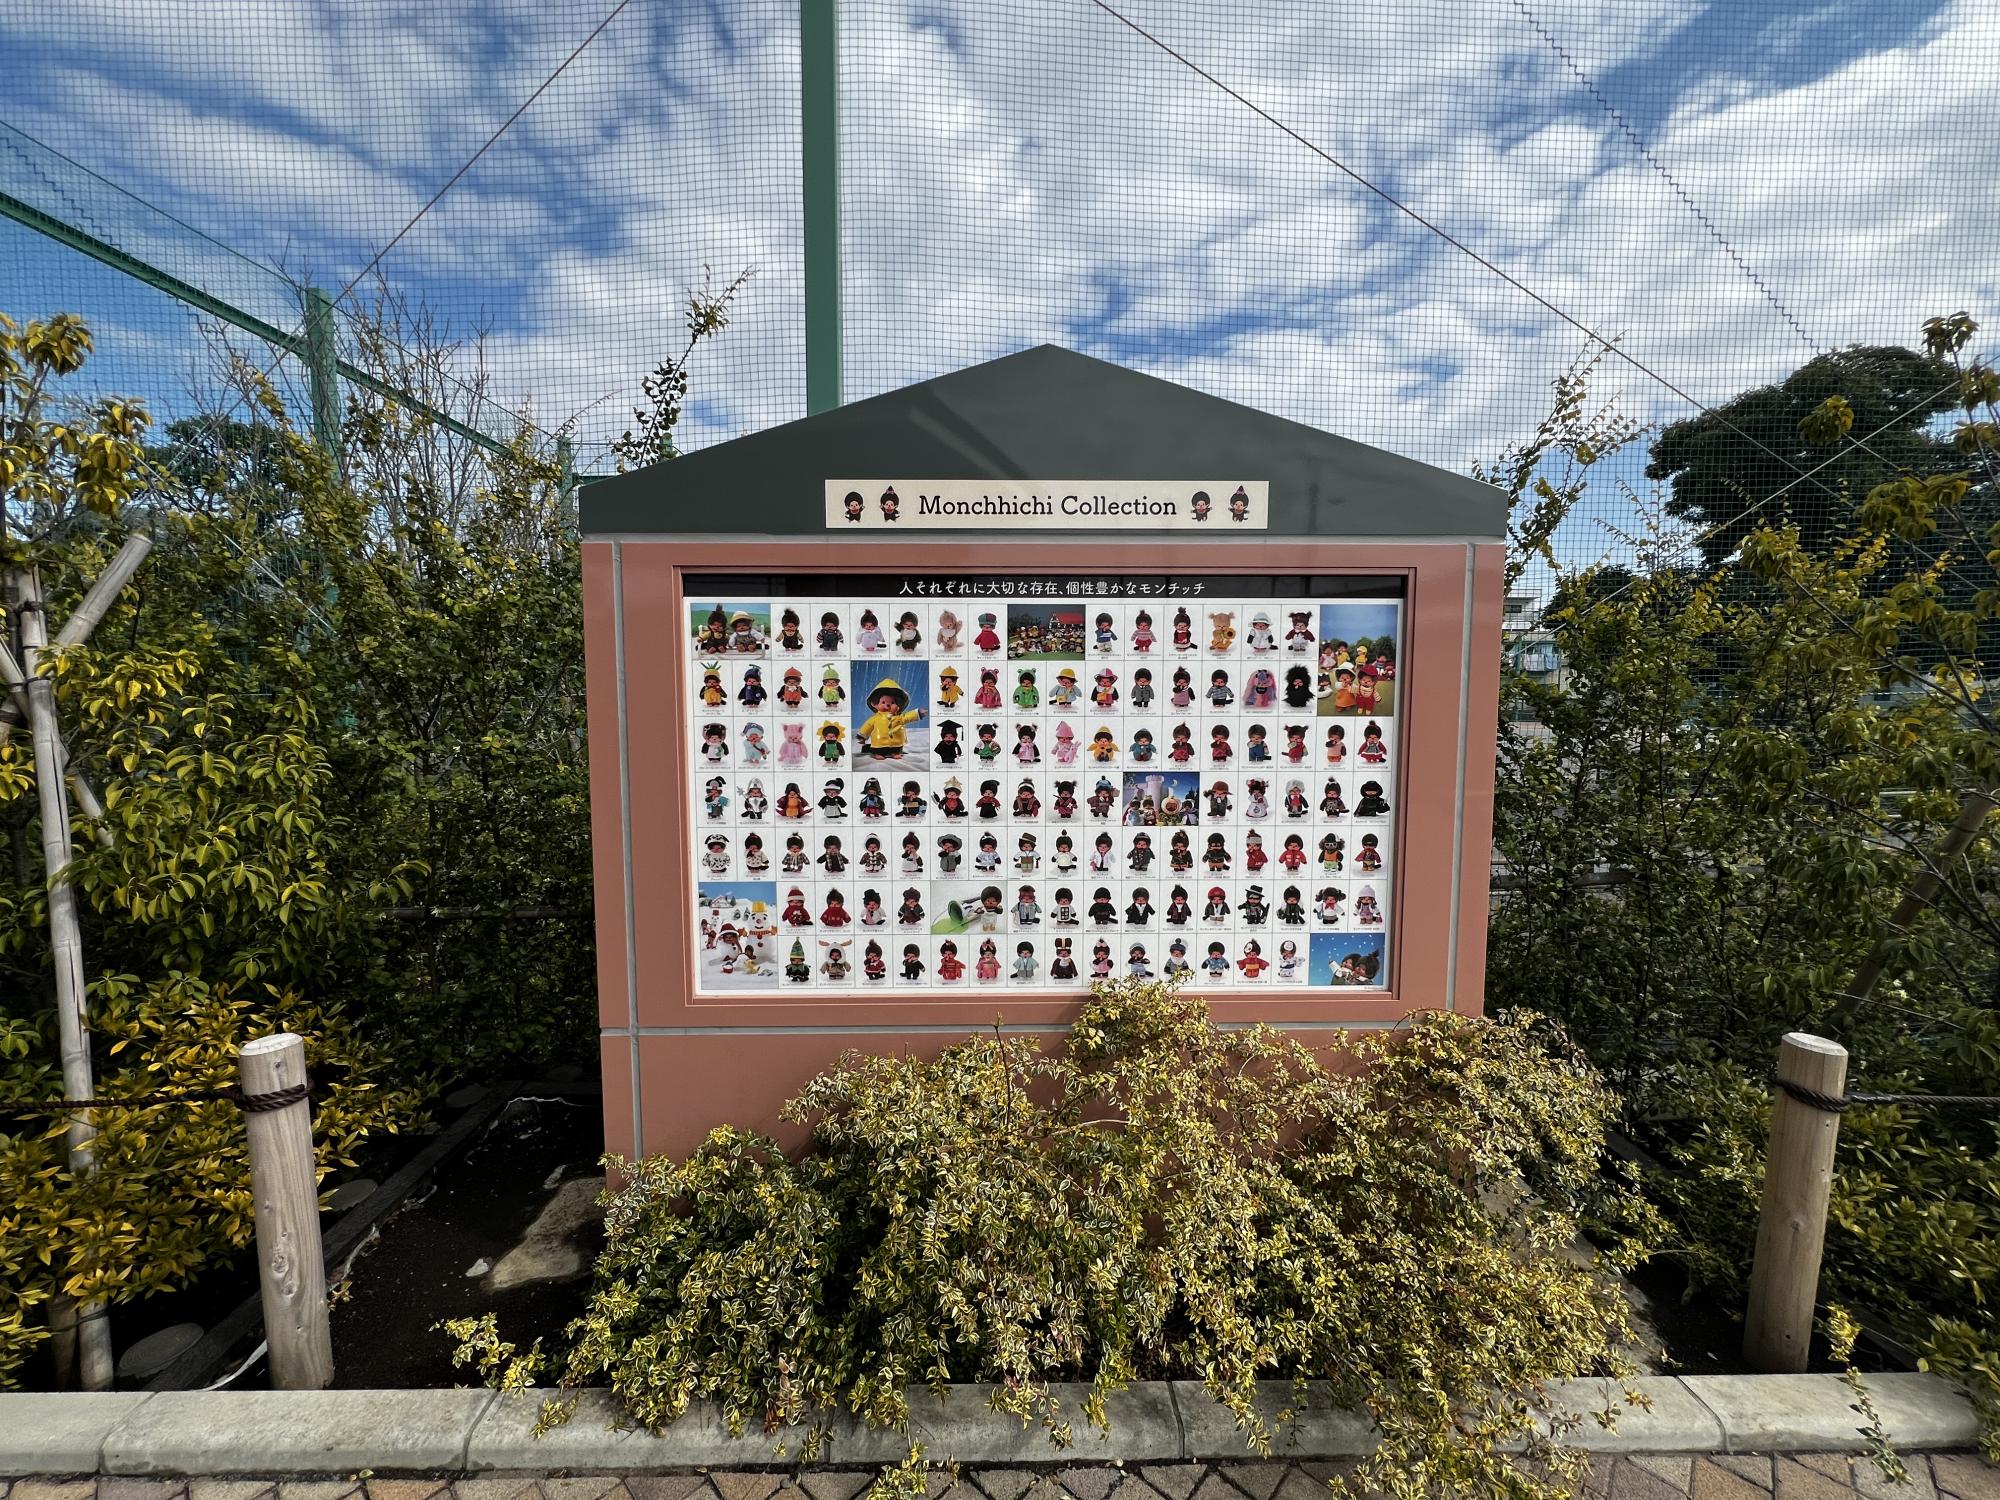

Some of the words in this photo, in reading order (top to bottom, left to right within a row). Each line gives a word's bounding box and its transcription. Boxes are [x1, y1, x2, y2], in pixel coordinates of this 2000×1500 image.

[919, 495, 1053, 515] Monchhichi
[1061, 495, 1177, 515] Collection
[899, 580, 1205, 595] 人それぞれに大切な存在、個性豊かなモンチッチ
